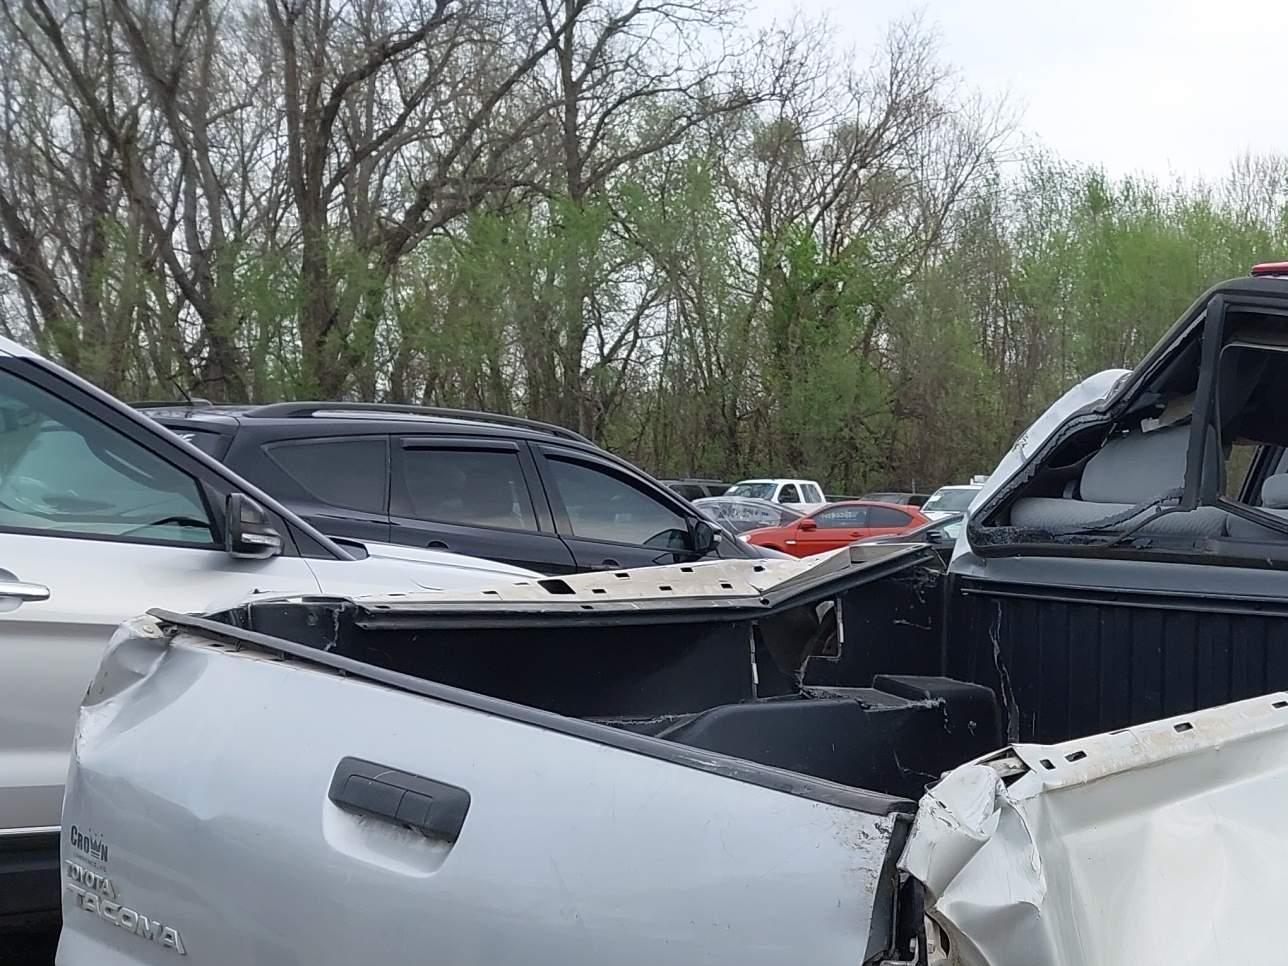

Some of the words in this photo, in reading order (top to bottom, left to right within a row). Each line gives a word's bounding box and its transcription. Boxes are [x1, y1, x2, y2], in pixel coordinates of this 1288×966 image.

[71, 825, 108, 862] CROWN
[65, 860, 117, 900] TOYOTA
[68, 883, 187, 956] TACOMA
